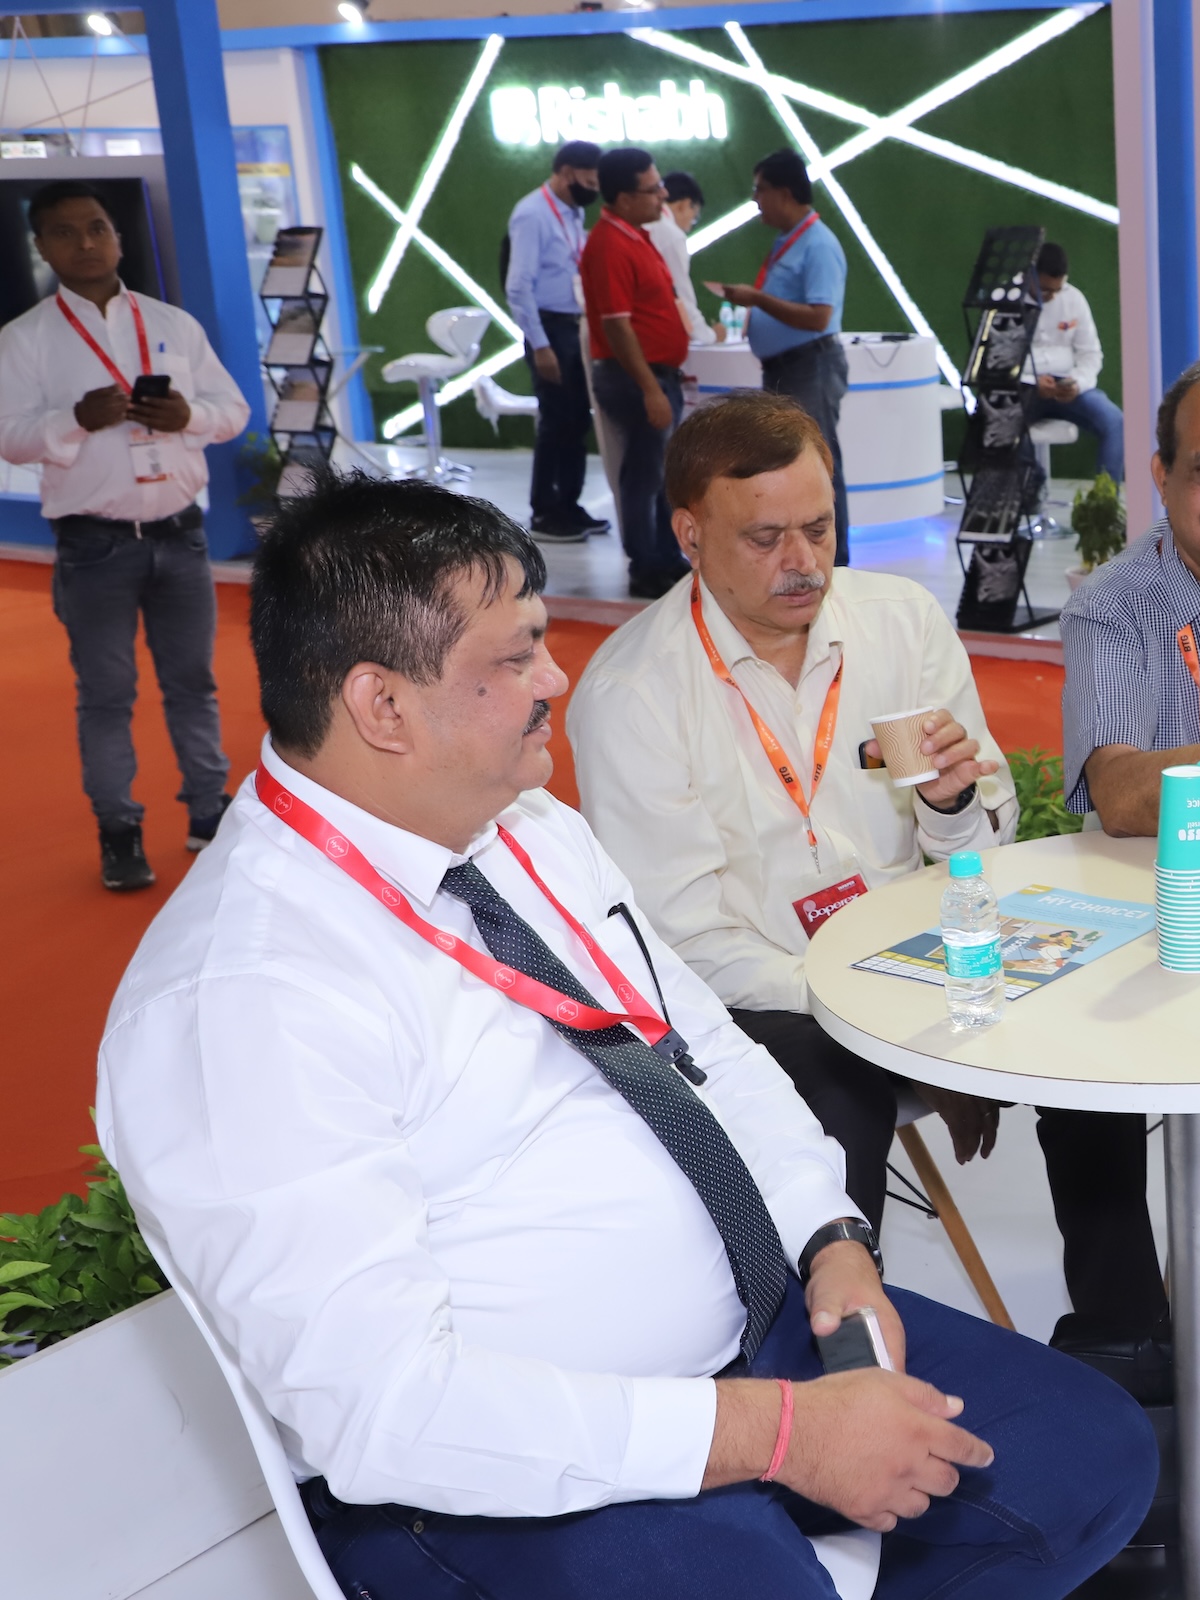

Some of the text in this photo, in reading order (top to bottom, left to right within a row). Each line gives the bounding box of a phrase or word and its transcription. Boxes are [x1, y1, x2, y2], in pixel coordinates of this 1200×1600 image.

[537, 79, 728, 143] Rishabh
[1180, 635, 1191, 652] BTG
[779, 766, 794, 784] BTG
[813, 763, 822, 782] BTG
[330, 840, 345, 853] Hyve
[1038, 895, 1072, 906] MY
[560, 1005, 576, 1016] Hyve
